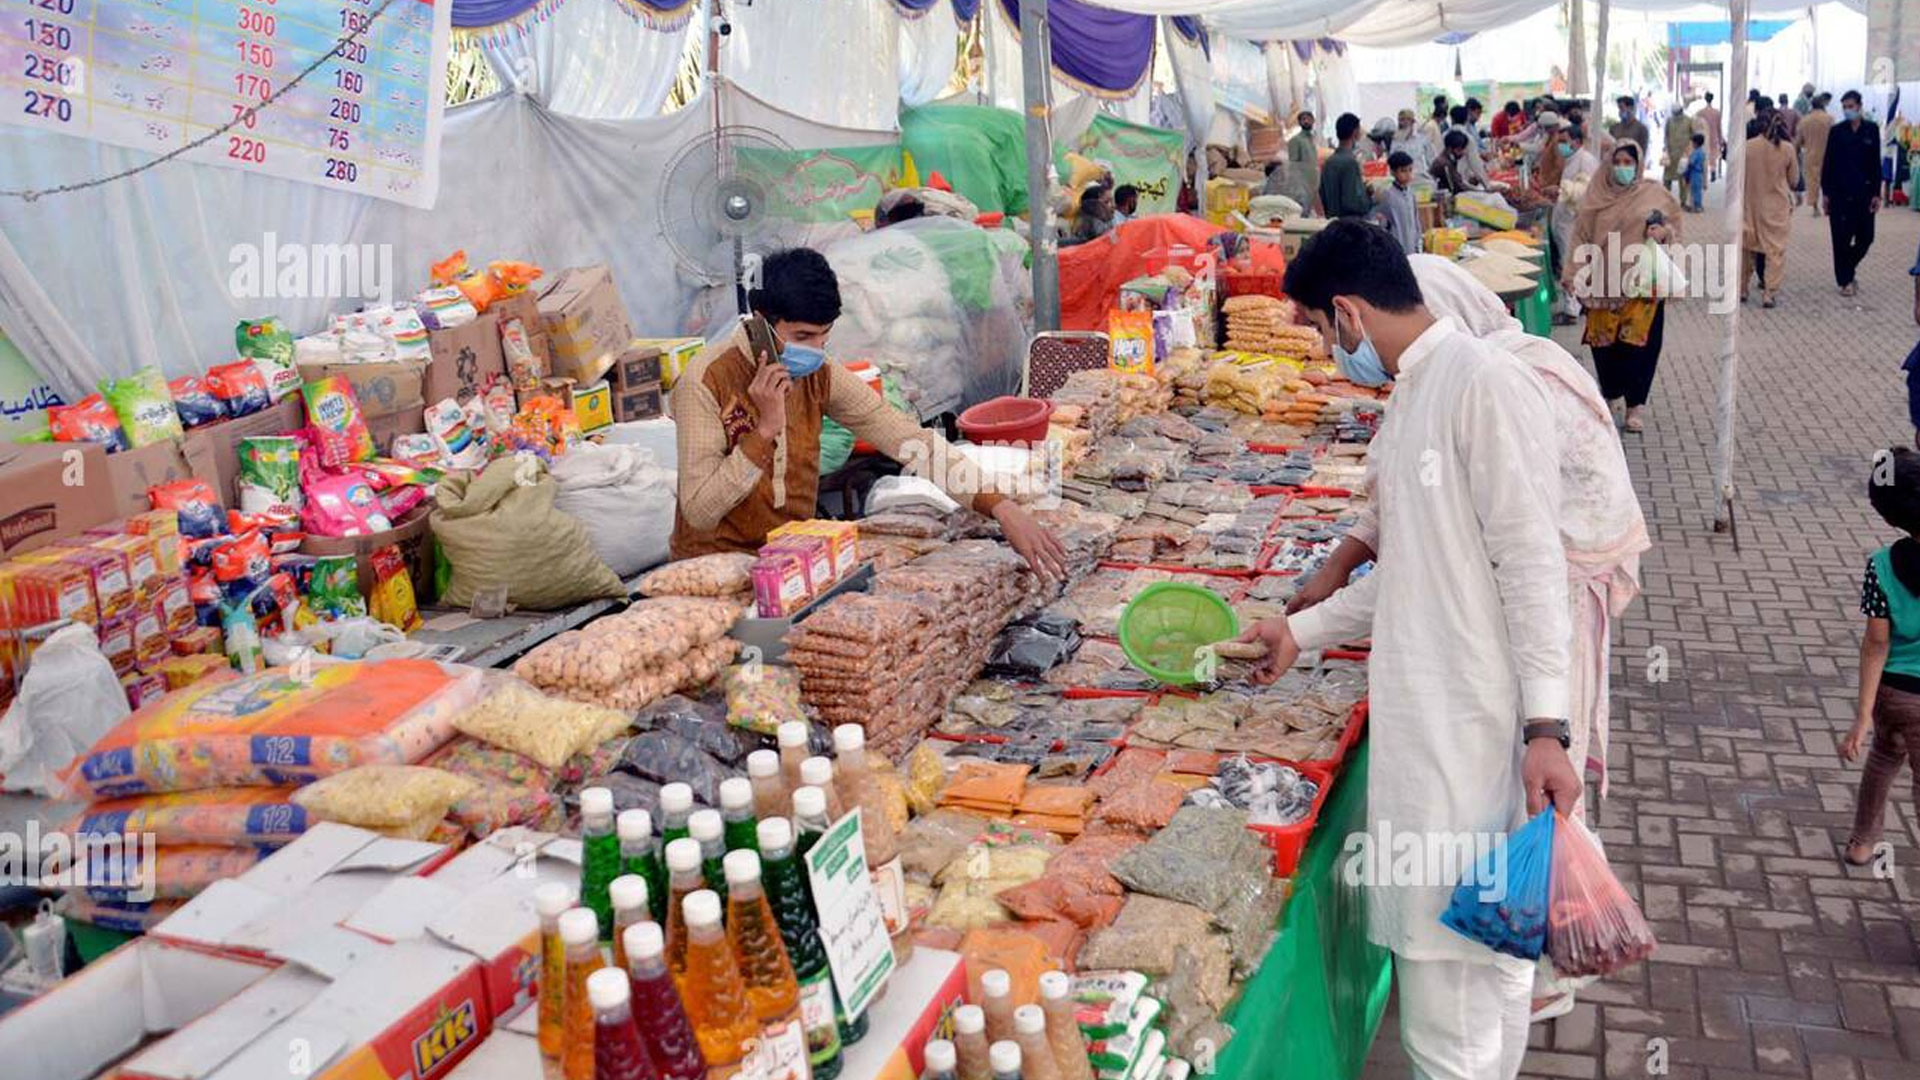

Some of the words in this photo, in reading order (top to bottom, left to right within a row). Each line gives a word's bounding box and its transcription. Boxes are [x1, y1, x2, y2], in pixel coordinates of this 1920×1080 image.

[25, 18, 71, 50] 150
[238, 8, 275, 36] 300
[236, 41, 273, 68] 150
[336, 38, 366, 64] 320
[24, 54, 71, 85] 250
[335, 69, 363, 94] 160
[235, 73, 271, 101] 170
[24, 90, 71, 122] 270
[232, 104, 256, 129] 70
[228, 137, 266, 163] 220
[328, 128, 349, 150] 75
[325, 158, 356, 182] 280
[265, 736, 296, 764] 12
[262, 804, 293, 833] 12
[418, 1005, 473, 1073] KK
